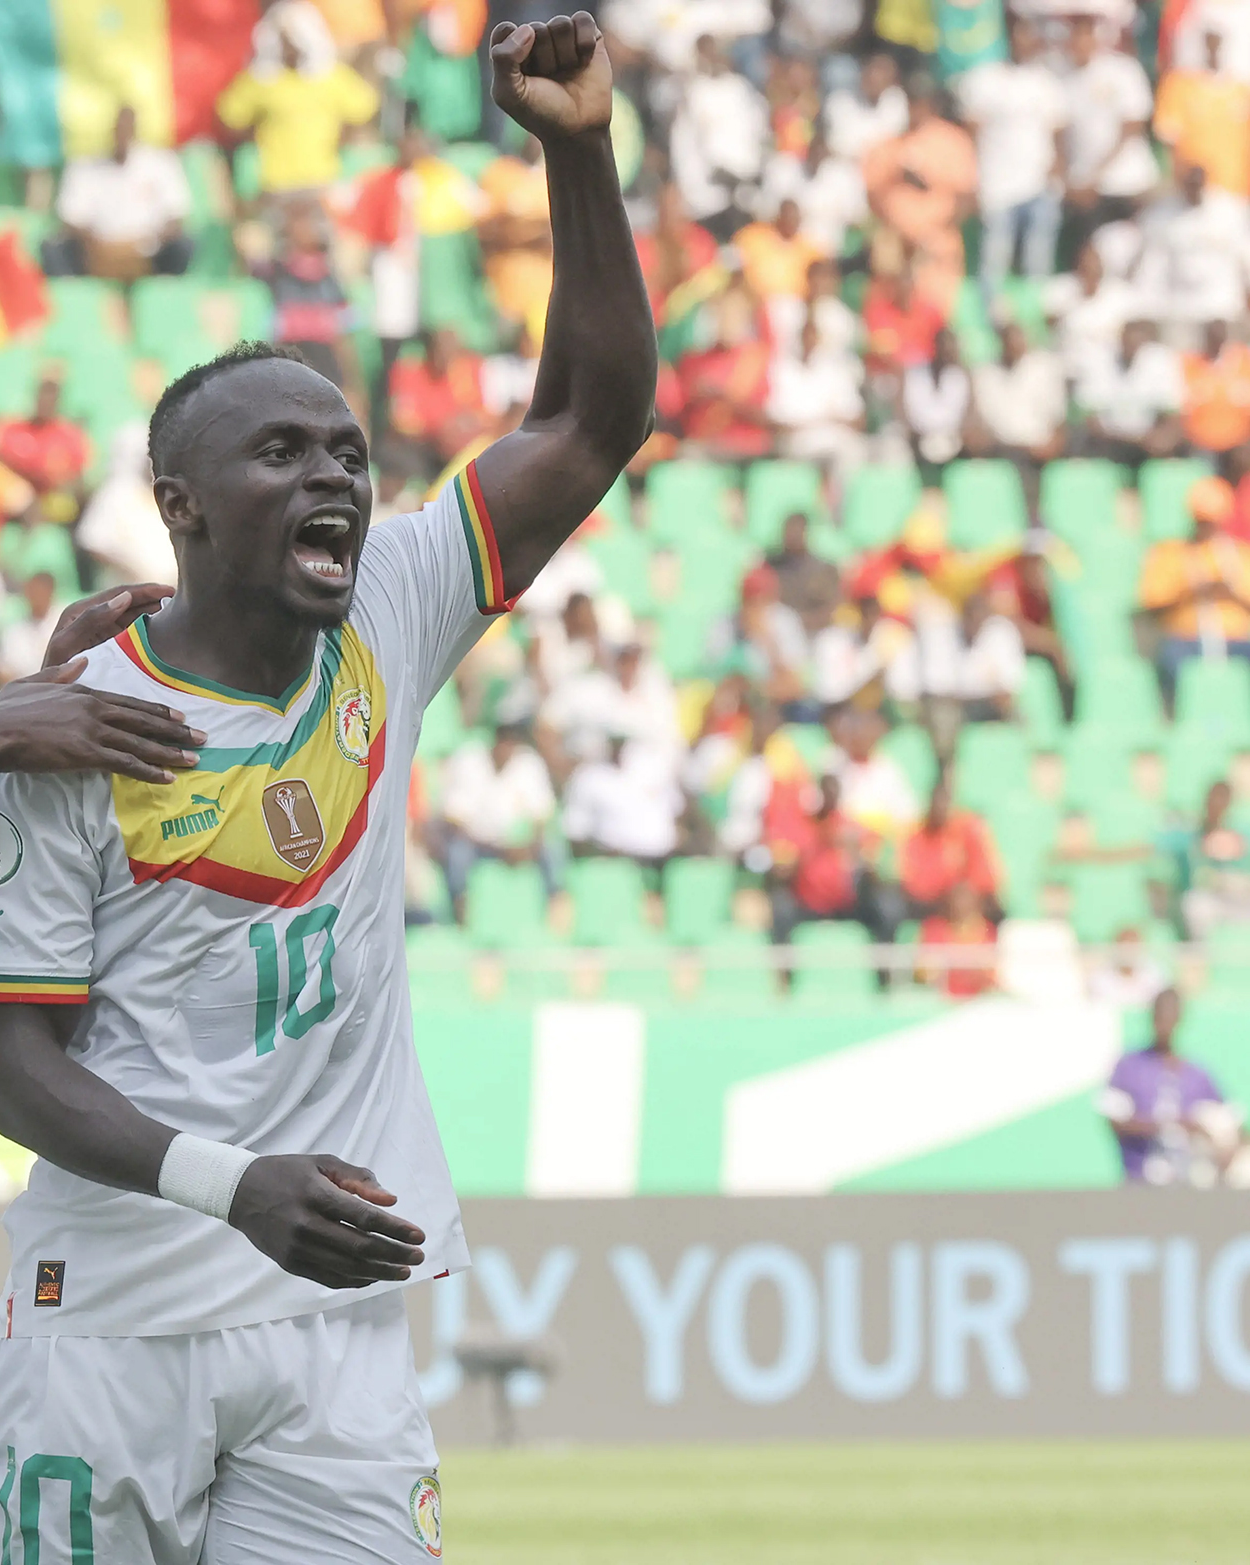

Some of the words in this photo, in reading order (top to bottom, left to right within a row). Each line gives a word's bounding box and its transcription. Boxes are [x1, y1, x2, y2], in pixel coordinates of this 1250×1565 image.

[160, 809, 220, 841] PUMA
[294, 850, 310, 860] 2021
[250, 903, 340, 1056] 10
[608, 1240, 1030, 1405] YOUR
